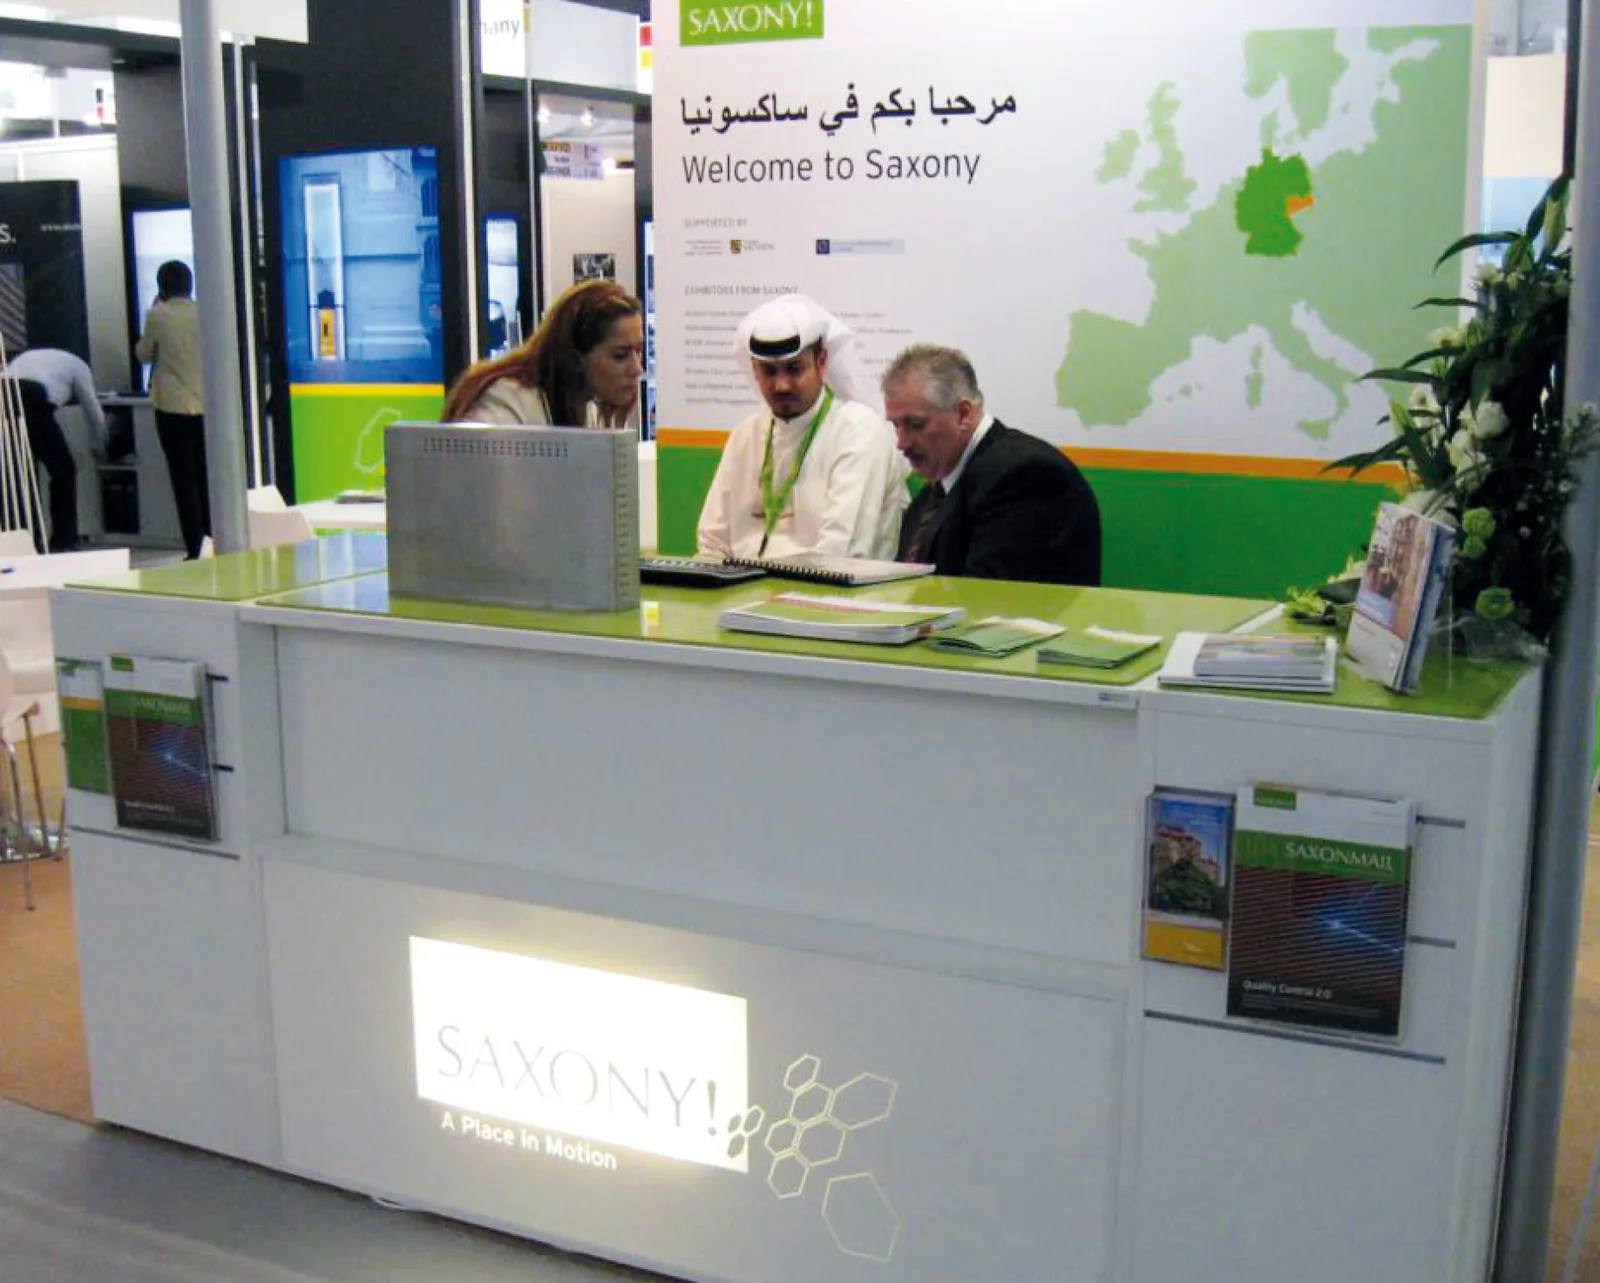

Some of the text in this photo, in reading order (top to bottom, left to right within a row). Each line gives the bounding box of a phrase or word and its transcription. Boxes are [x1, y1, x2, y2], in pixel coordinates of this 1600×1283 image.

[688, 0, 813, 35] SAXONY!
[680, 83, 1017, 136] مرحبا بكم في ساكسونيا
[682, 149, 981, 185] Welcome to Saxony
[437, 1024, 717, 1137] SAXONY!
[441, 1111, 618, 1172] A Place in Motion
